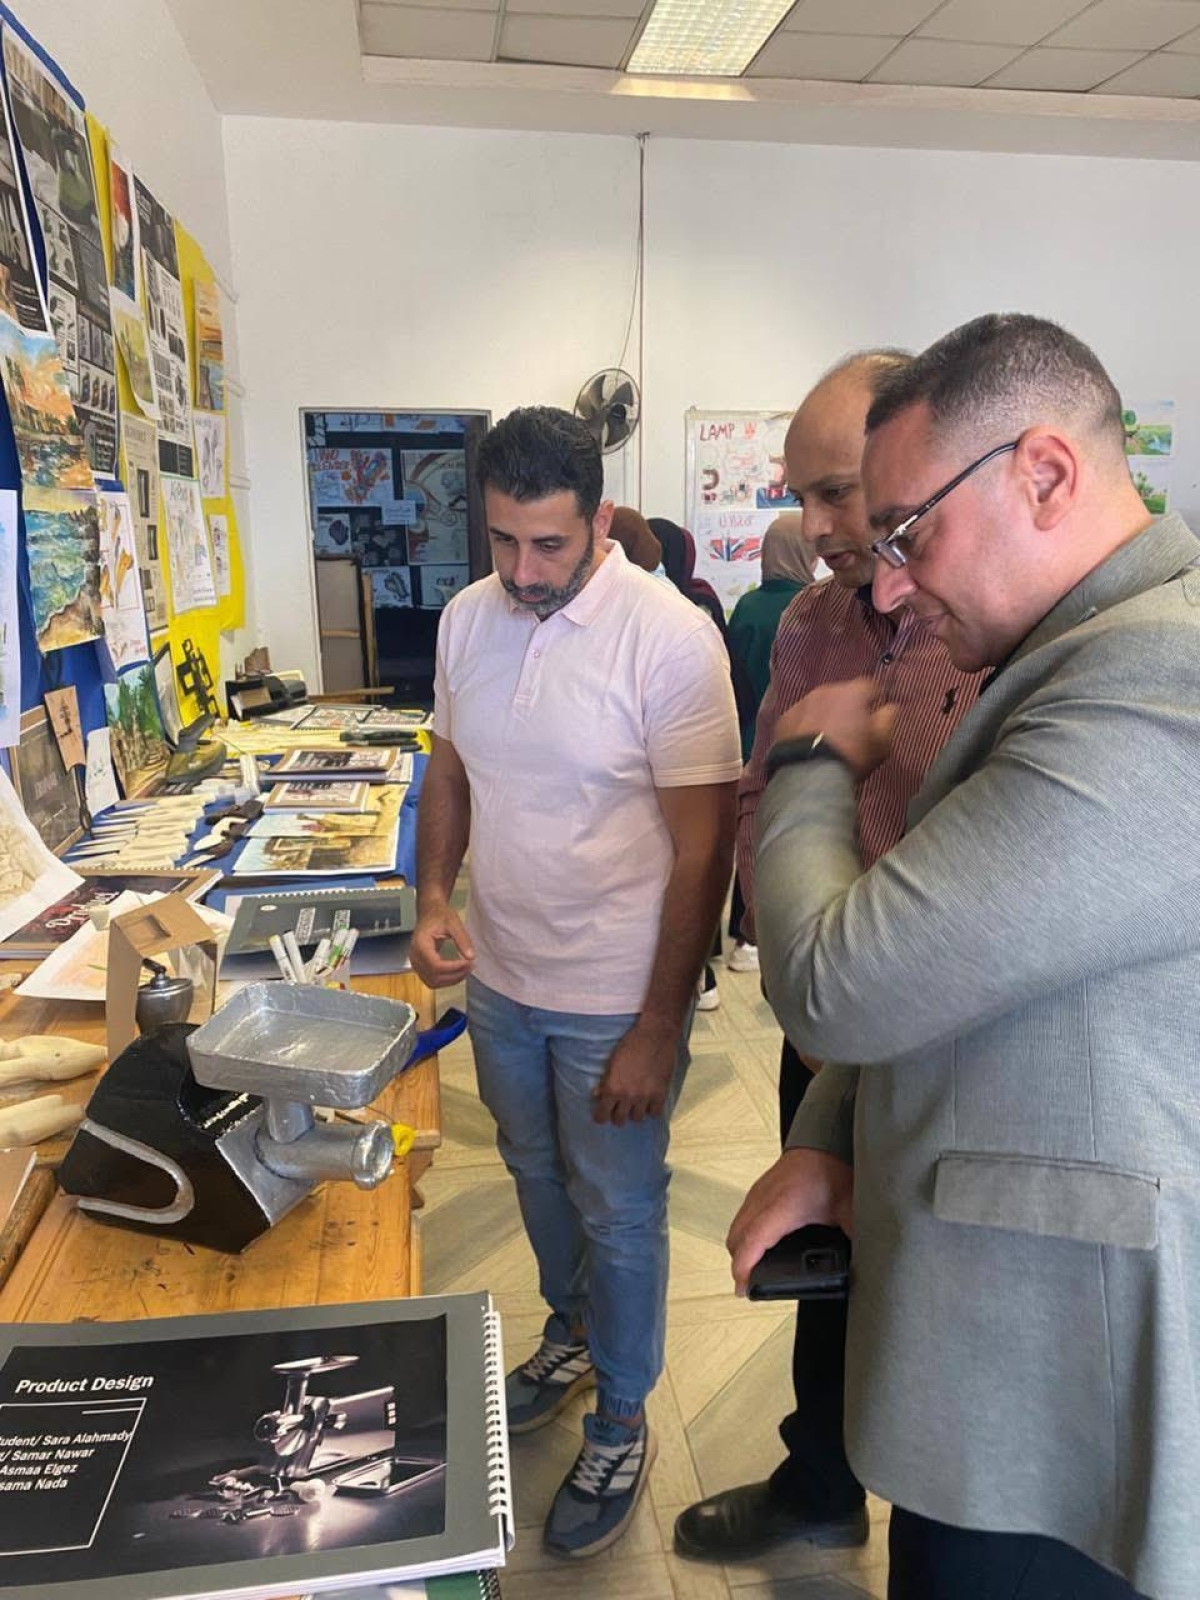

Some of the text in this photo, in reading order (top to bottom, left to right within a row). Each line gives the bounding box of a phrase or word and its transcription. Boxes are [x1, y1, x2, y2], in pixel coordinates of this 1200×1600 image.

[700, 423, 735, 440] LAMP
[15, 1375, 154, 1393] Product Design
[0, 1430, 132, 1446] tudent/ Sara Alahmady
[12, 1450, 52, 1461] Samar
[54, 1448, 95, 1460] Nawar
[0, 1464, 78, 1476] Asmaa Elgez
[0, 1477, 69, 1491] sama Nada
